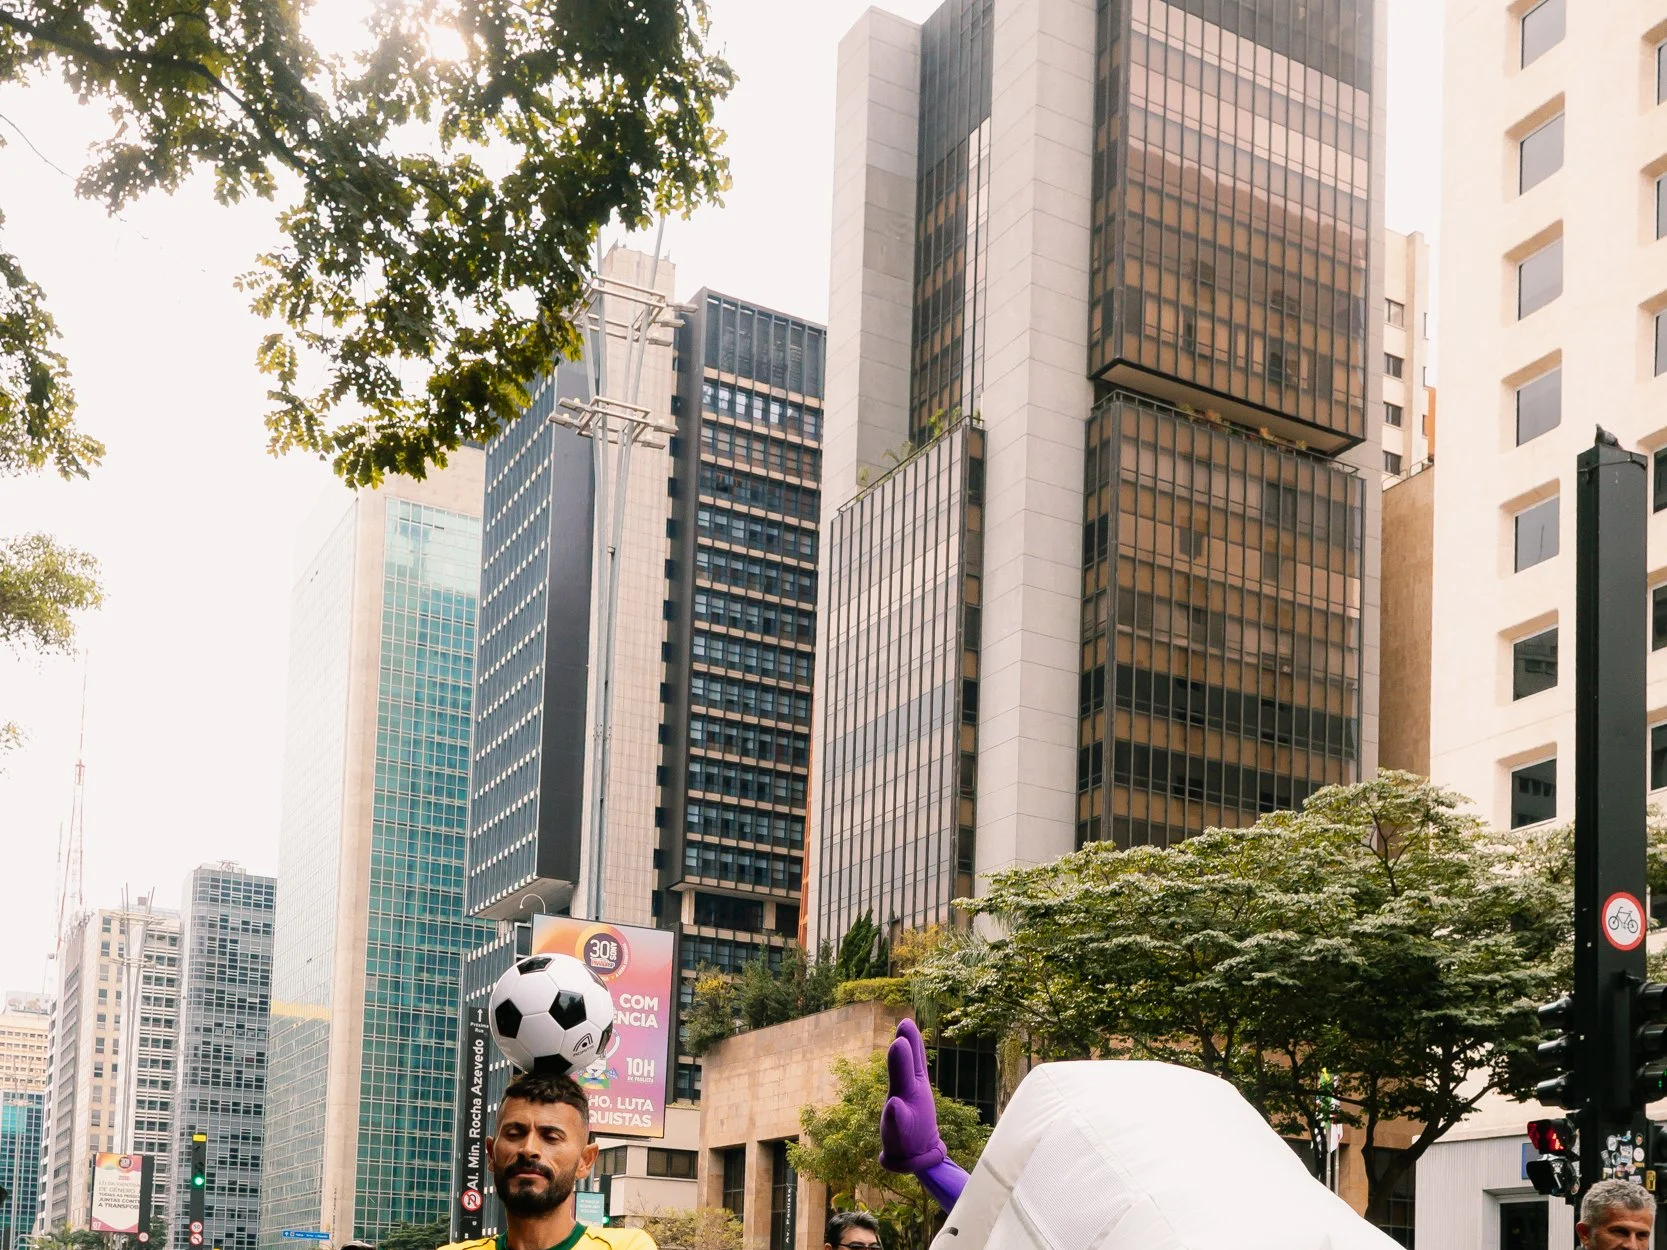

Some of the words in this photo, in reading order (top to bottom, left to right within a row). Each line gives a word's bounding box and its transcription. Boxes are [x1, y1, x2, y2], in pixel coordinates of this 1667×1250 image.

[589, 939, 610, 959] 30
[609, 941, 617, 961] ANOS
[619, 993, 658, 1011] COM
[471, 1039, 484, 1096] Azevedo
[626, 1057, 655, 1077] 10H
[616, 1096, 654, 1112] LUTA
[469, 1098, 482, 1138] Rocha
[588, 1109, 652, 1128] QUISTAS
[467, 1142, 480, 1168] Min.
[467, 1172, 479, 1190] Al.
